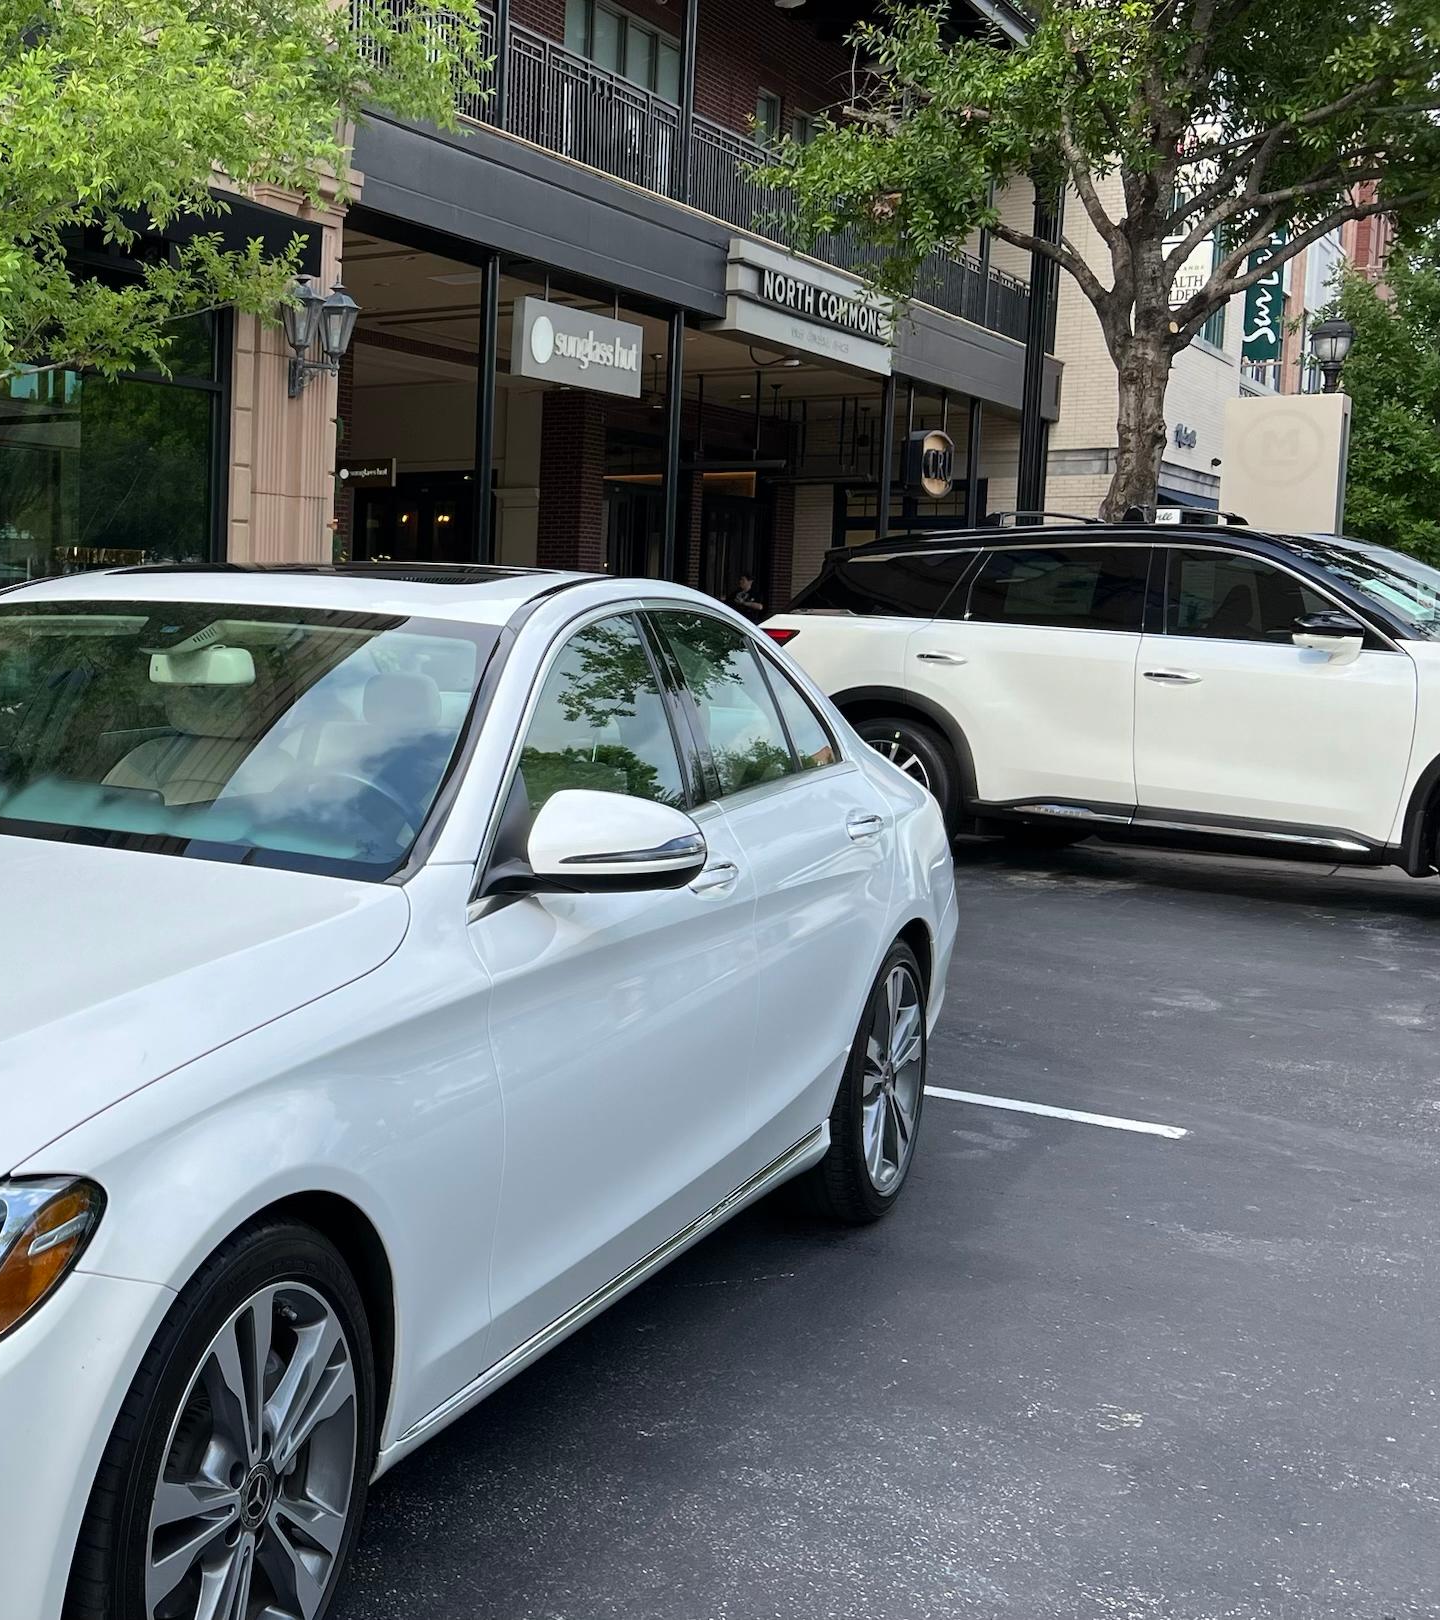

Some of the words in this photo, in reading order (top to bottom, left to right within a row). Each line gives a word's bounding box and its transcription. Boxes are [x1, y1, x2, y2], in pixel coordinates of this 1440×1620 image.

[763, 269, 815, 314] NORTH
[554, 329, 615, 369] sunglass
[614, 336, 638, 371] hut
